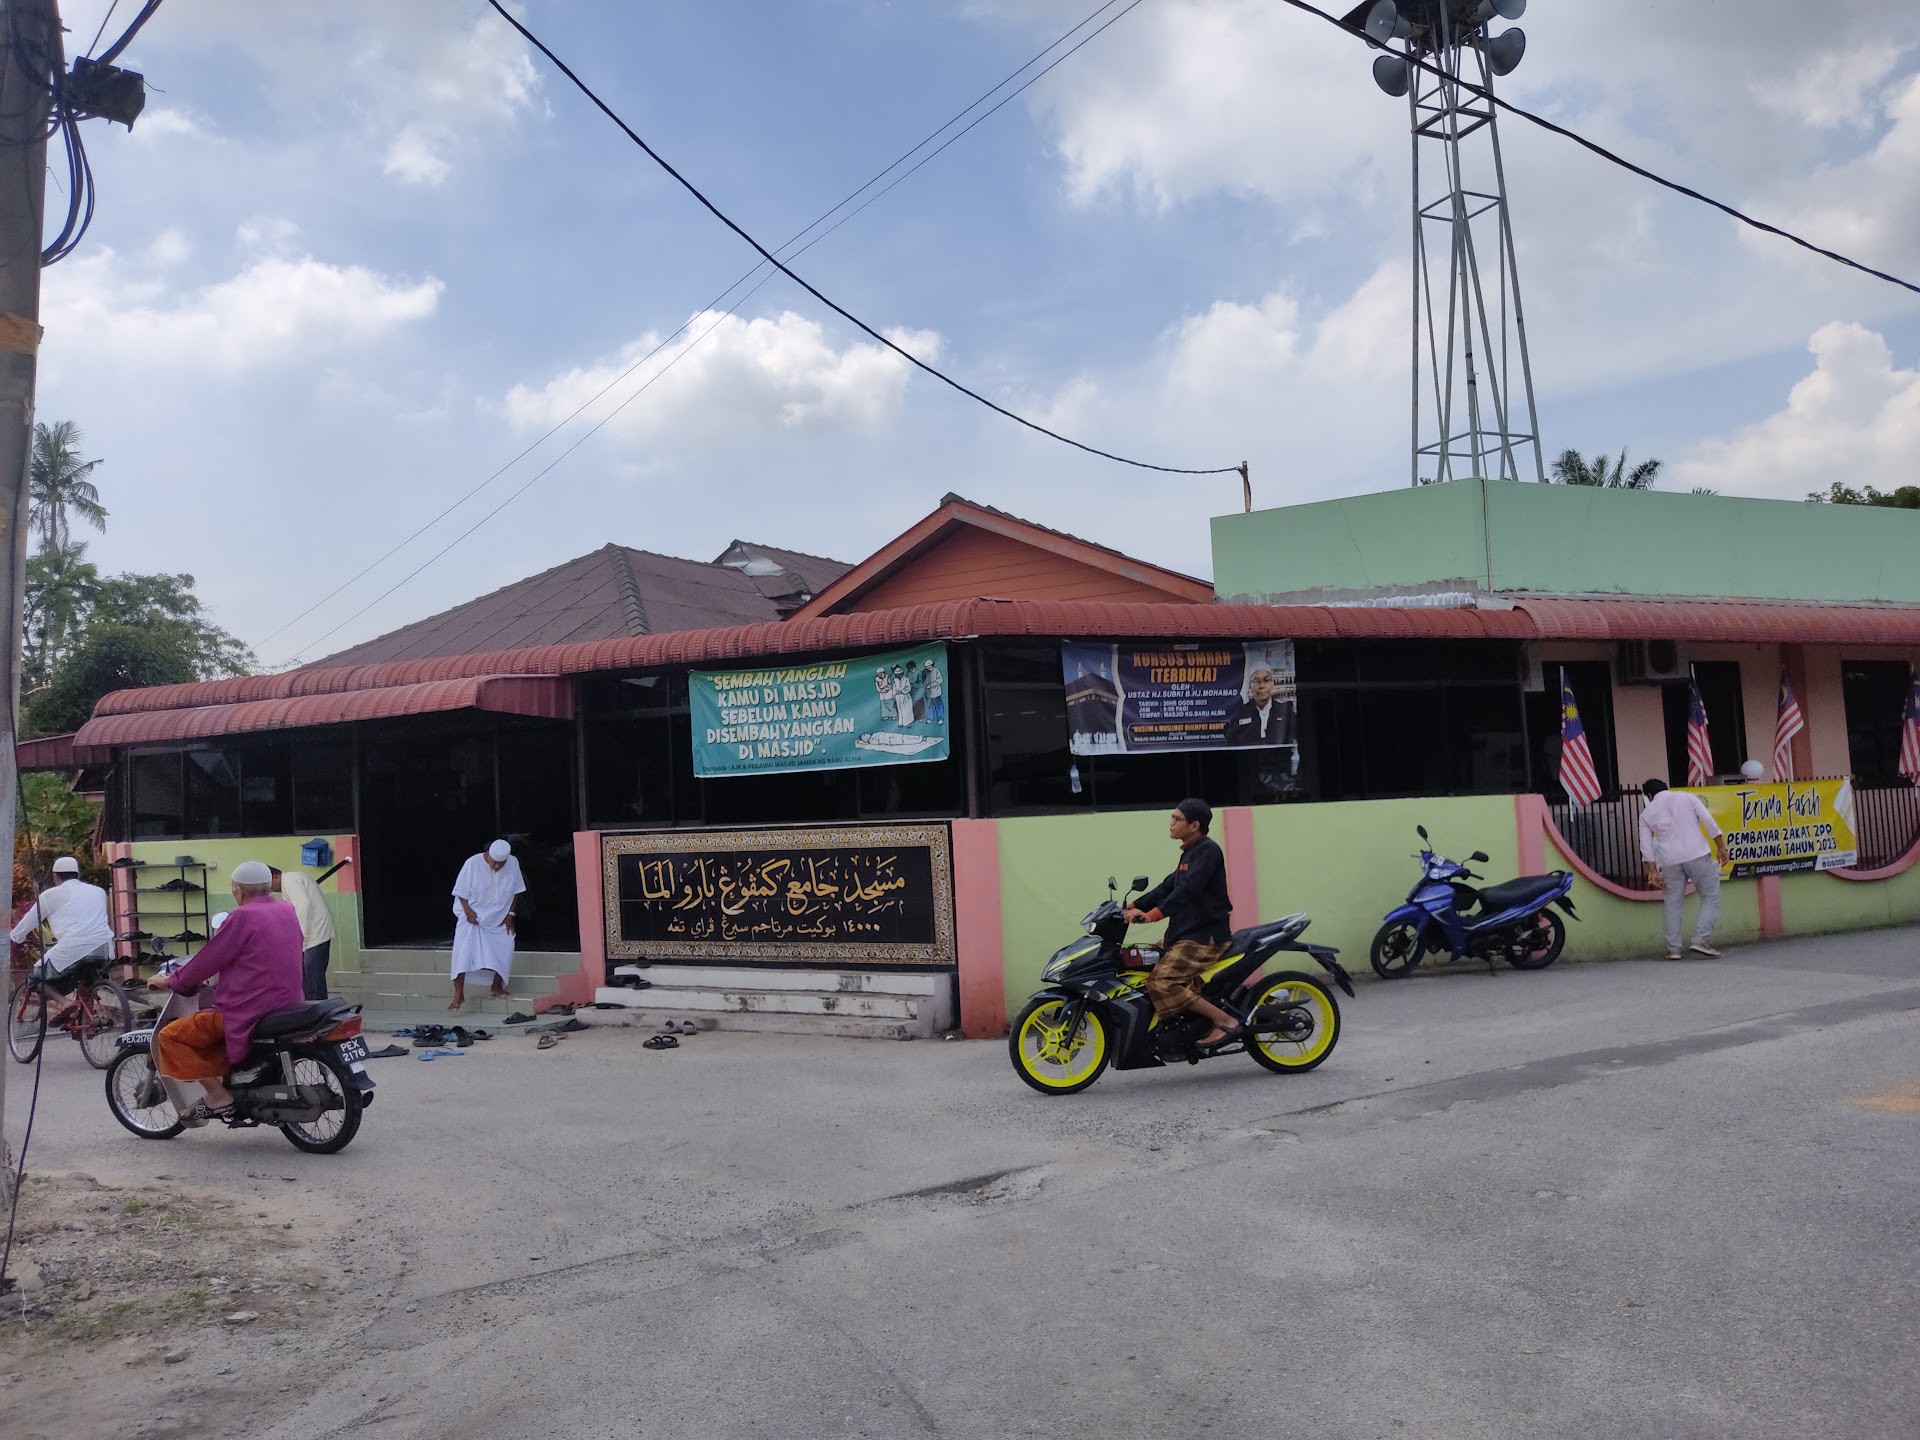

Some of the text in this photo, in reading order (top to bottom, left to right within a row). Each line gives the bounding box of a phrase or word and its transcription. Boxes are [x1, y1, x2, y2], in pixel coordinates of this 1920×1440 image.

[1133, 651, 1231, 667] KURSUS UMRAH
[717, 681, 841, 708] KAMU DI MASJID
[720, 700, 837, 725] SEBELUM KAMU
[706, 718, 855, 744] DISEMBAHYANGKAN
[739, 744, 753, 760] DI
[1736, 790, 1782, 827] Terima
[1727, 830, 1780, 846] PEMBAYAR
[1783, 826, 1812, 842] ZAKAT
[1725, 845, 1783, 861] EPANJANG
[1784, 841, 1815, 856] TAHUN
[1818, 837, 1837, 851] 2023
[340, 1039, 359, 1052] PEX
[342, 1048, 366, 1061] 2176
